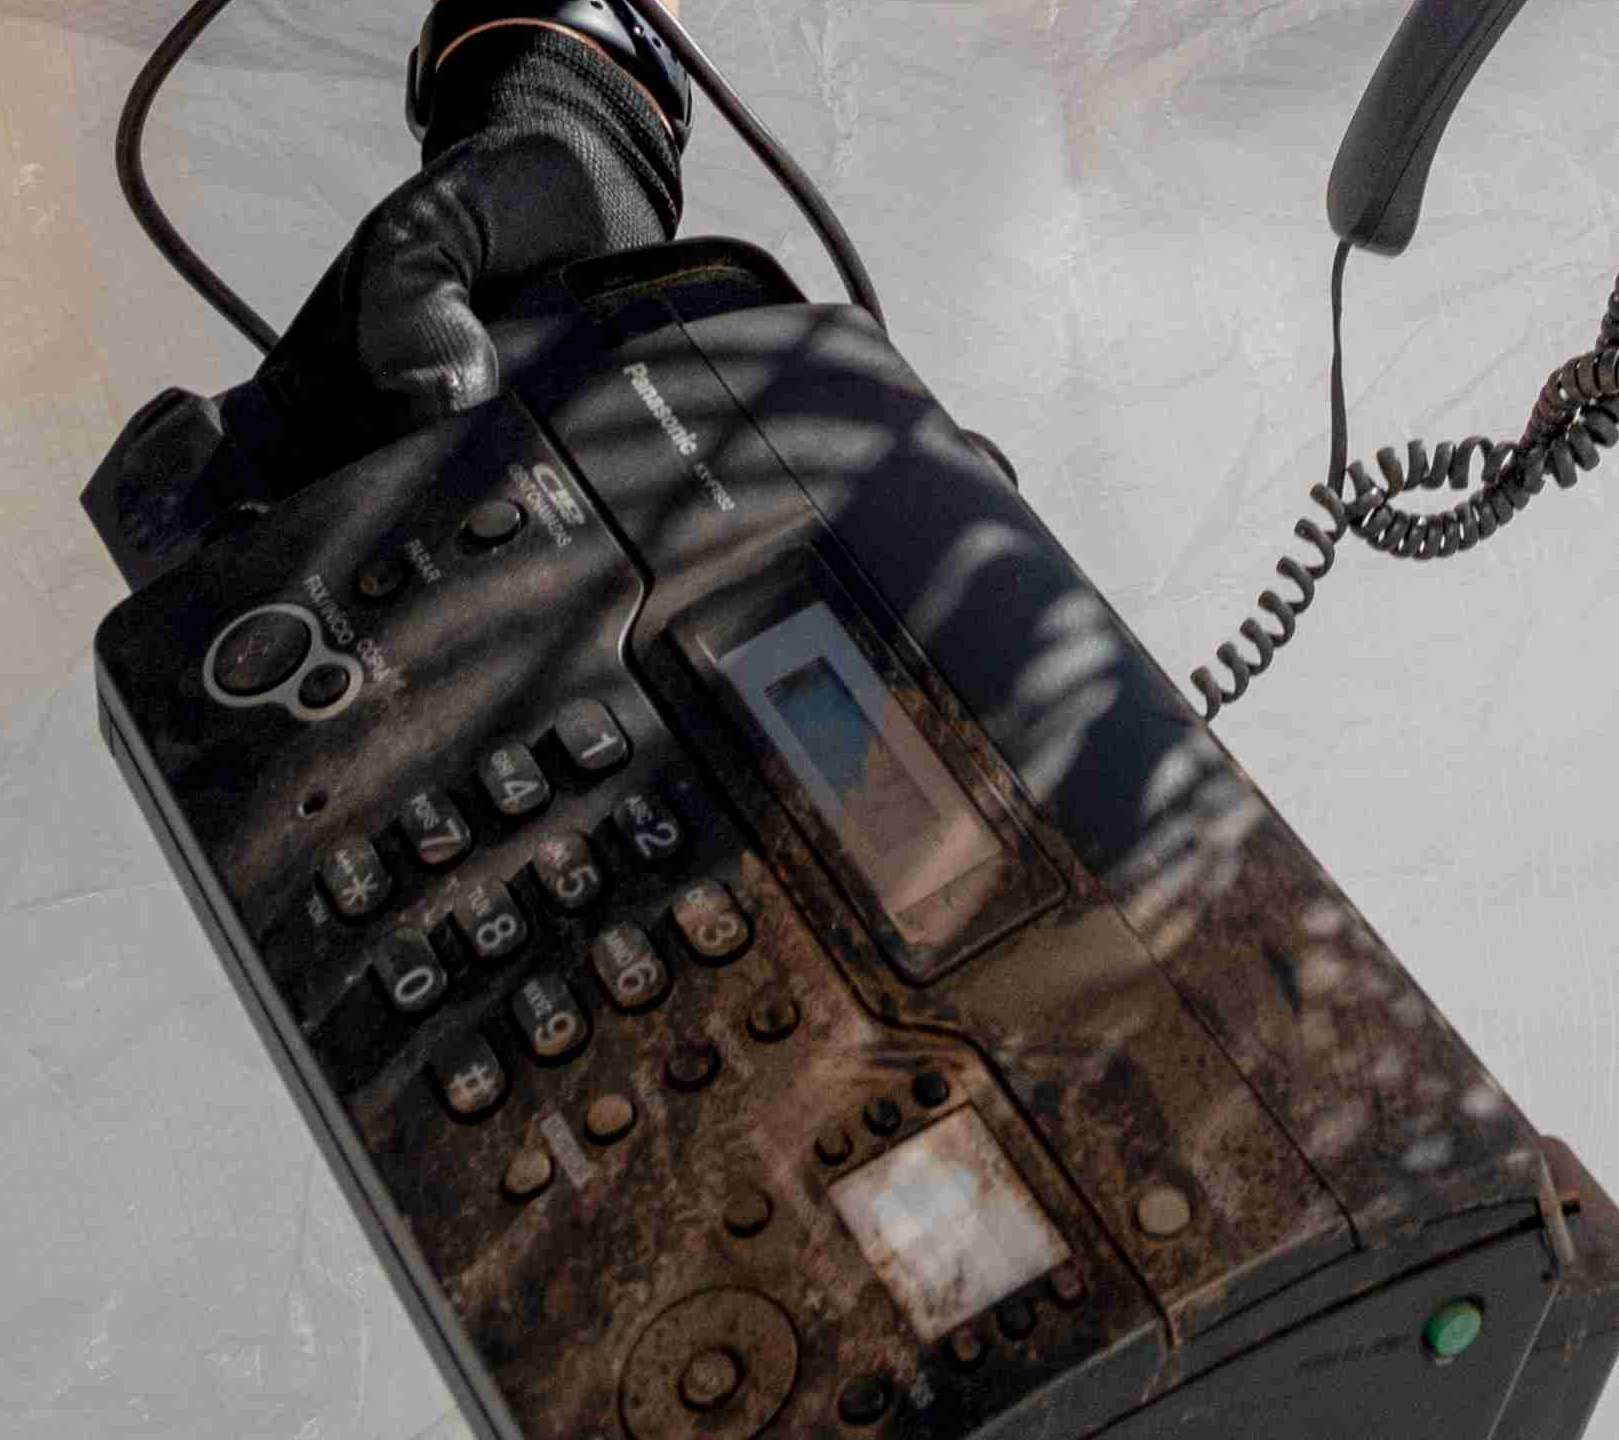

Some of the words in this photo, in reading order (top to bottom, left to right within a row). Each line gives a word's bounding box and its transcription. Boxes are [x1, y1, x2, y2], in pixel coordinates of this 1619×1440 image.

[622, 361, 698, 456] Panasonic
[581, 734, 617, 759] 1
[500, 780, 539, 809] 4
[418, 819, 462, 850] 7
[634, 821, 678, 859] 2
[555, 864, 599, 899] 5
[477, 913, 518, 949] 8
[697, 914, 740, 947] 3
[616, 963, 660, 995] 6
[532, 1009, 579, 1047] 9
